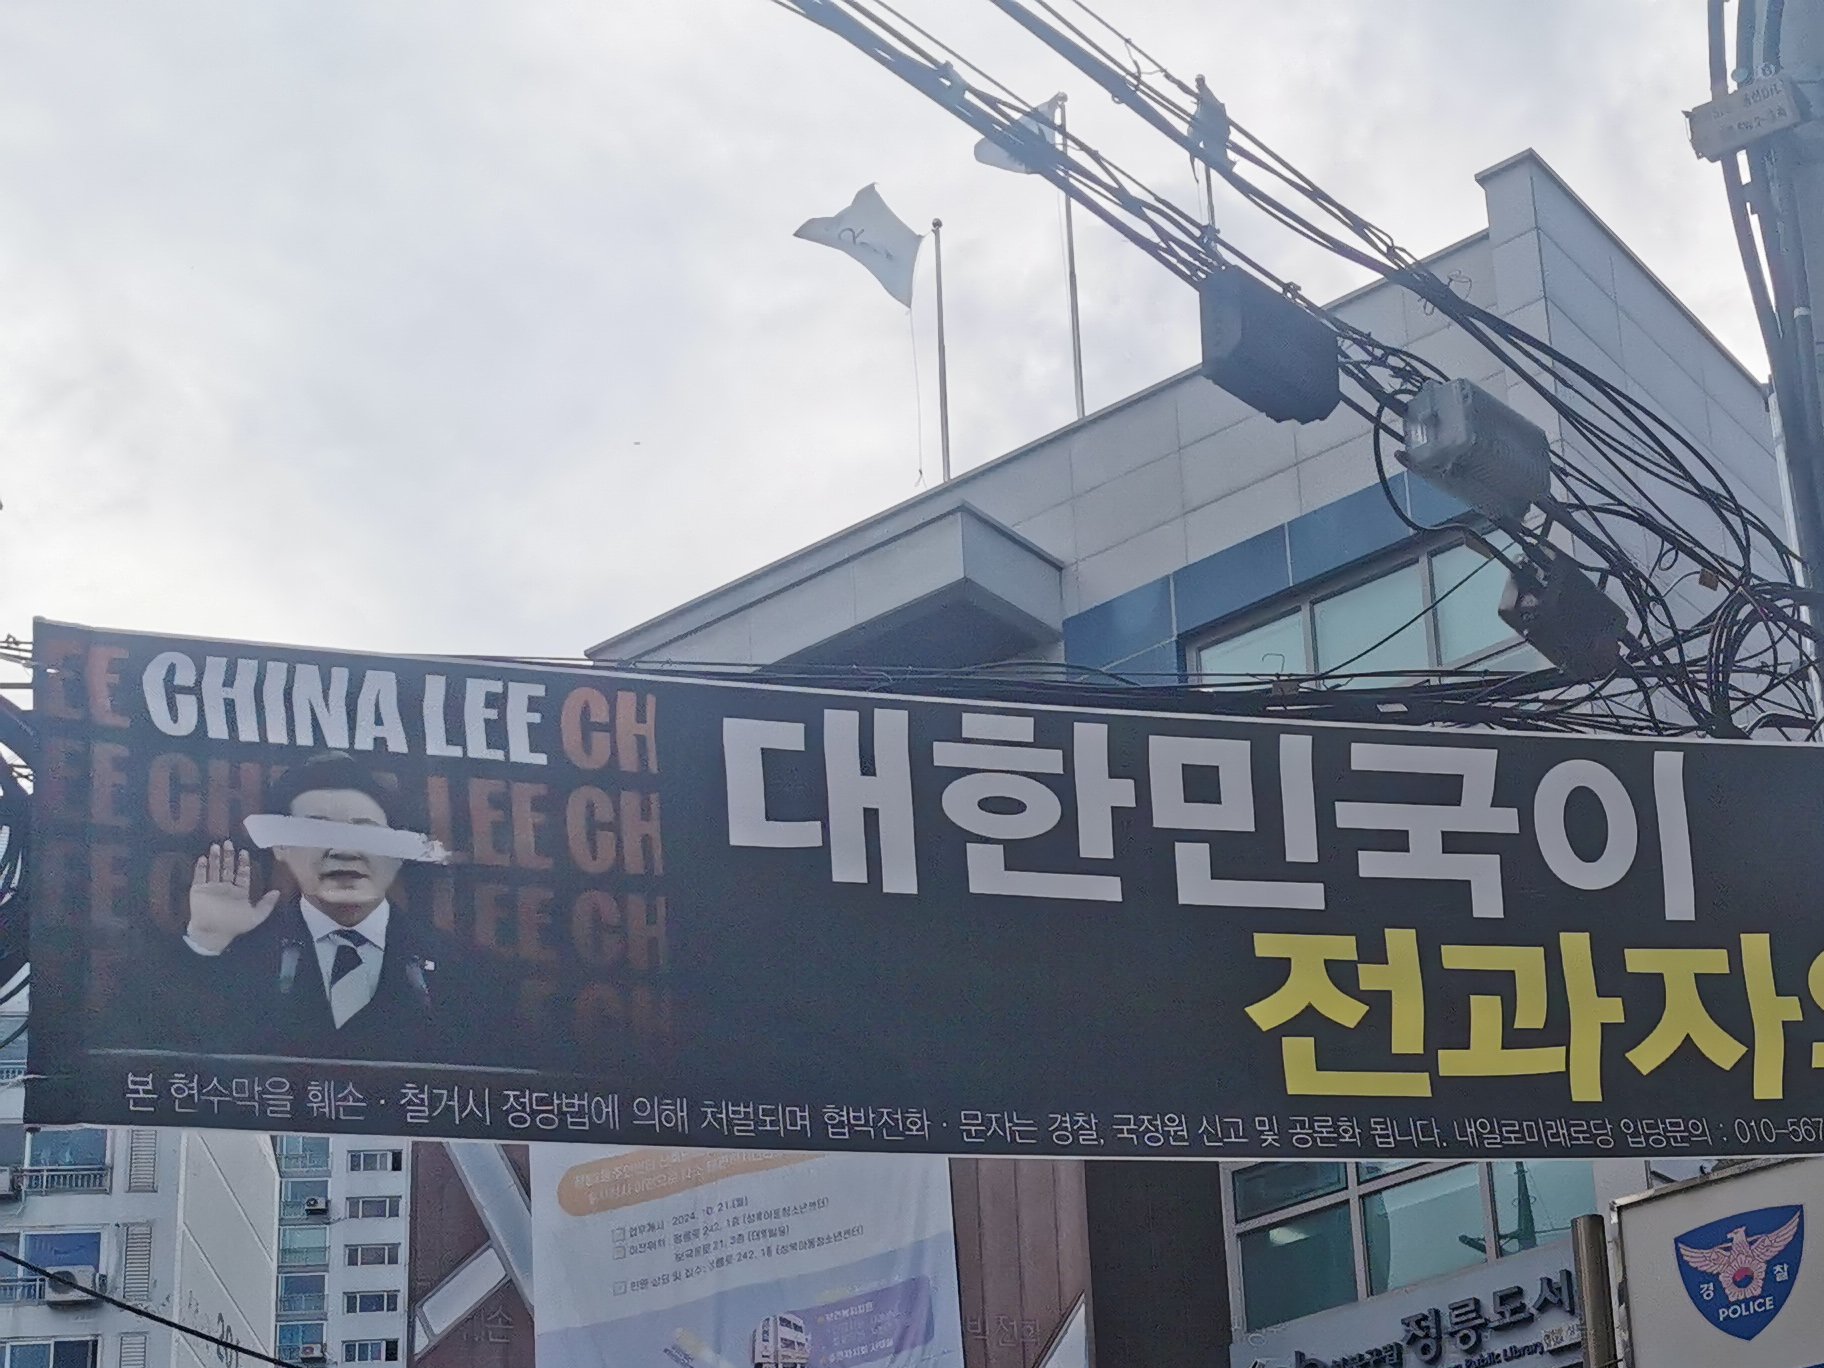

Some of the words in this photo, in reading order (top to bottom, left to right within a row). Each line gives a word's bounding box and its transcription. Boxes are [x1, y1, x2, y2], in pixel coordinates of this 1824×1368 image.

[143, 651, 409, 754] CHINA
[423, 672, 548, 766] LEE
[561, 686, 658, 775] CH
[721, 709, 1697, 922] 대한민국이
[126, 1071, 159, 1113] 본
[169, 1072, 294, 1121] 현수막을
[308, 1081, 368, 1122] 훼손
[401, 1082, 492, 1126] 철거시
[502, 1088, 619, 1132] 정당법에
[632, 1096, 689, 1135] 의해
[700, 1100, 811, 1138] 처벌되며
[822, 1103, 930, 1142] 협박전화
[959, 1109, 1038, 1144] 문자는
[1048, 1111, 1106, 1147] 경찰,
[1112, 1112, 1190, 1147] 국정원
[1199, 1114, 1249, 1147] 신고
[1256, 1114, 1281, 1148] 및
[1288, 1115, 1361, 1149] 공론화
[1370, 1116, 1448, 1149] 됩니다.
[1453, 1117, 1615, 1150] 내일로미래로당
[1620, 1117, 1713, 1149] 입당문의
[1718, 1296, 1775, 1322] POLICE
